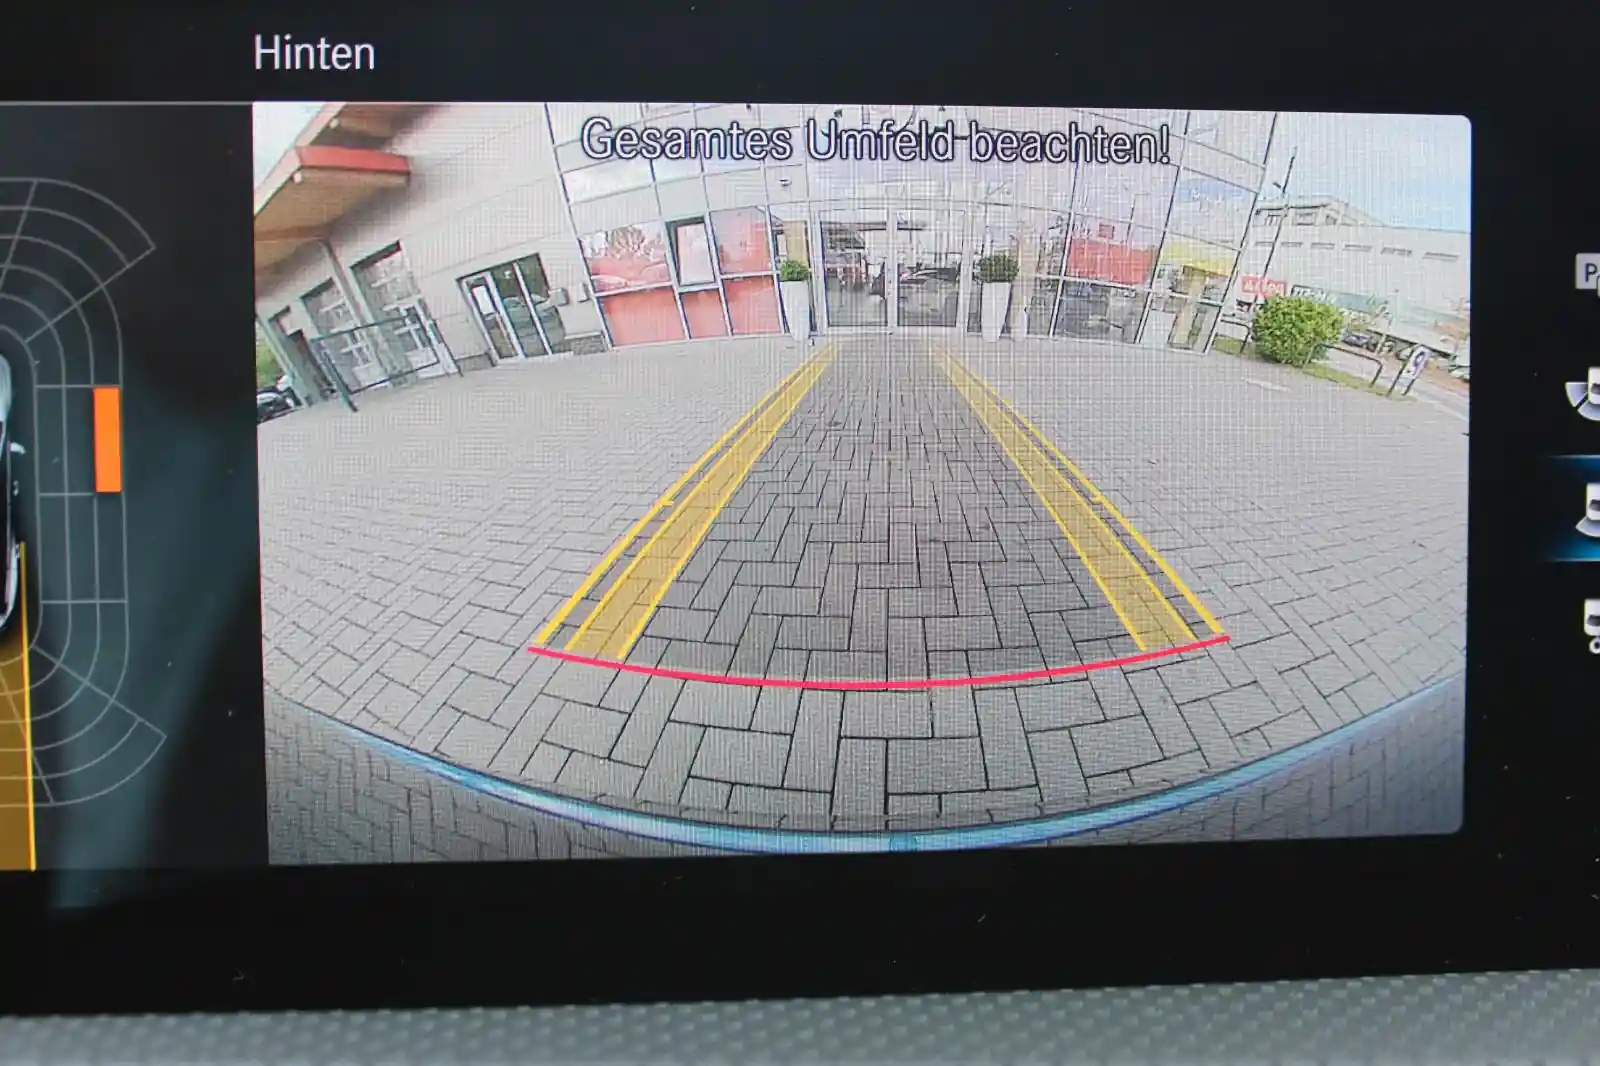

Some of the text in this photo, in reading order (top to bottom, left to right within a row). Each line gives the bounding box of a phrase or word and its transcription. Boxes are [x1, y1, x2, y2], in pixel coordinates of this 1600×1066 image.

[254, 33, 375, 70] Hinten
[581, 116, 1171, 164] Gesamtes Umfeld beachten!
[1585, 262, 1598, 283] P
